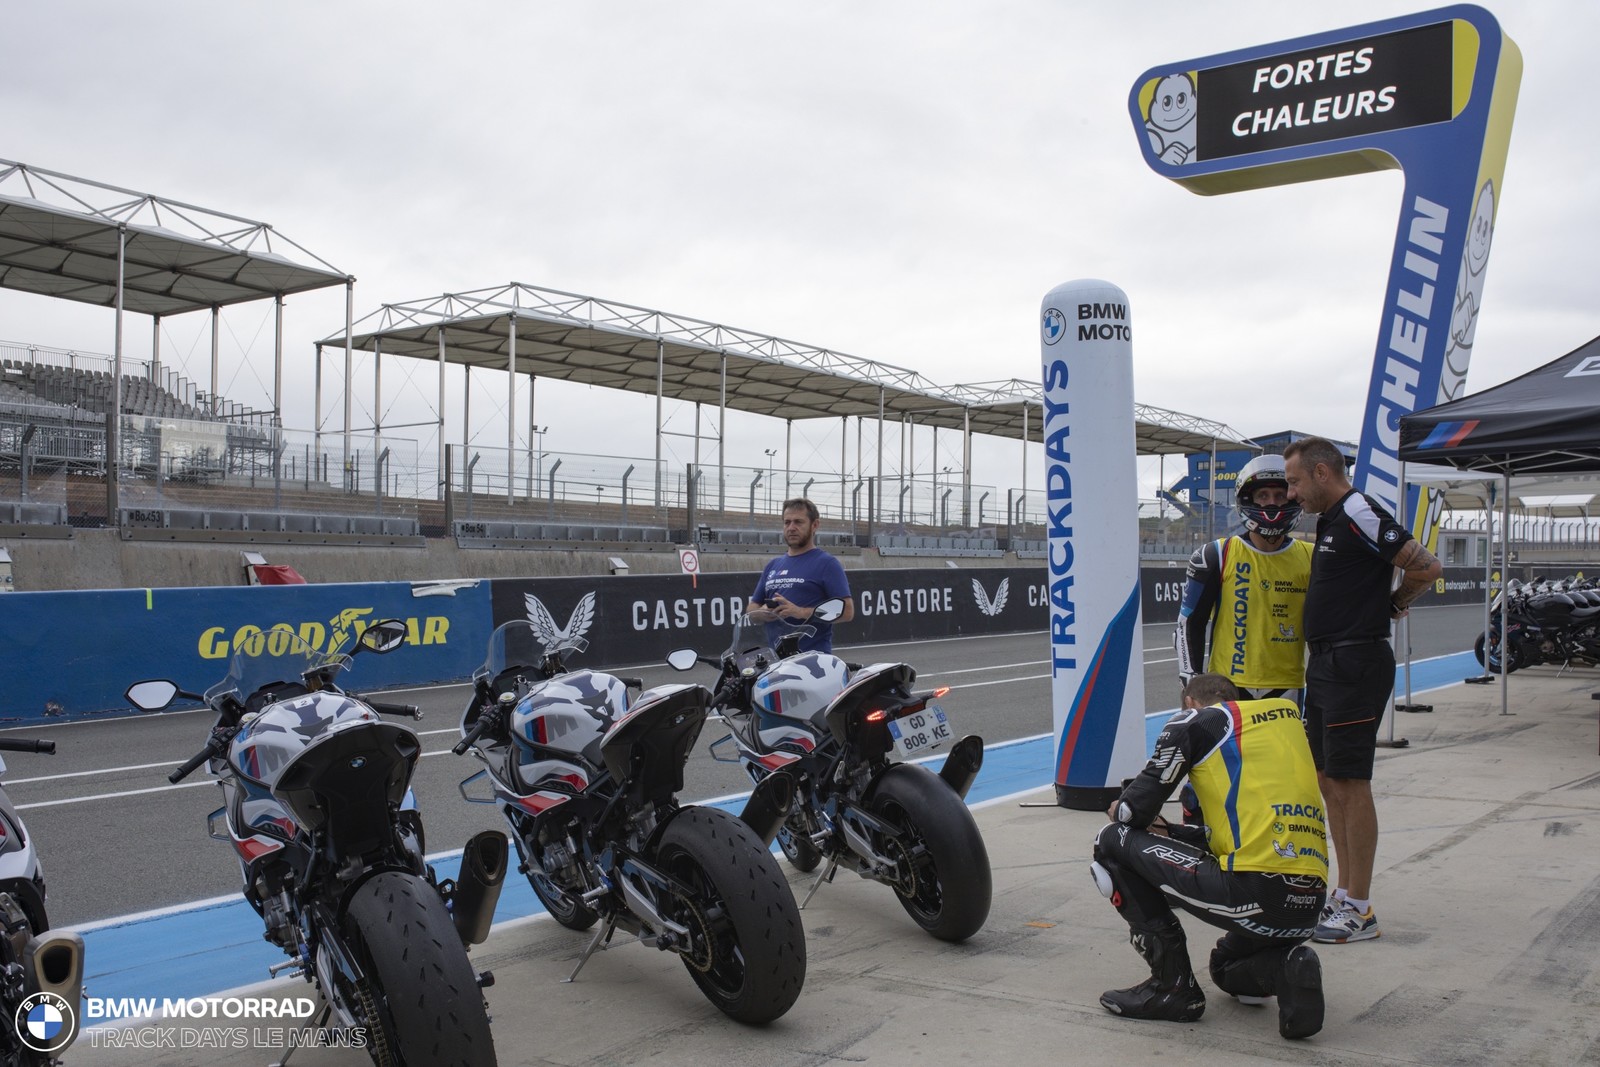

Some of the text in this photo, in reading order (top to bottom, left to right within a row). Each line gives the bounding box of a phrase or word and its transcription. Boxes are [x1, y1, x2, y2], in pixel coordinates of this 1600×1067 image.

[1252, 47, 1374, 93] FORTES
[1231, 86, 1397, 137] CHALEURS
[1077, 303, 1126, 320] BMW
[151, 511, 161, 522] 53
[1043, 359, 1077, 679] TRACKDAYS
[1445, 580, 1476, 592] motorsport.tv
[632, 596, 757, 631] CASTOR
[861, 587, 953, 616] CASTORE
[1231, 562, 1251, 676] TRACKDAYS
[198, 616, 450, 660] GOODYAR
[909, 715, 926, 729] GD
[904, 724, 950, 750] 808 KE
[1289, 824, 1311, 833] BMW
[1233, 918, 1280, 938] ALEX
